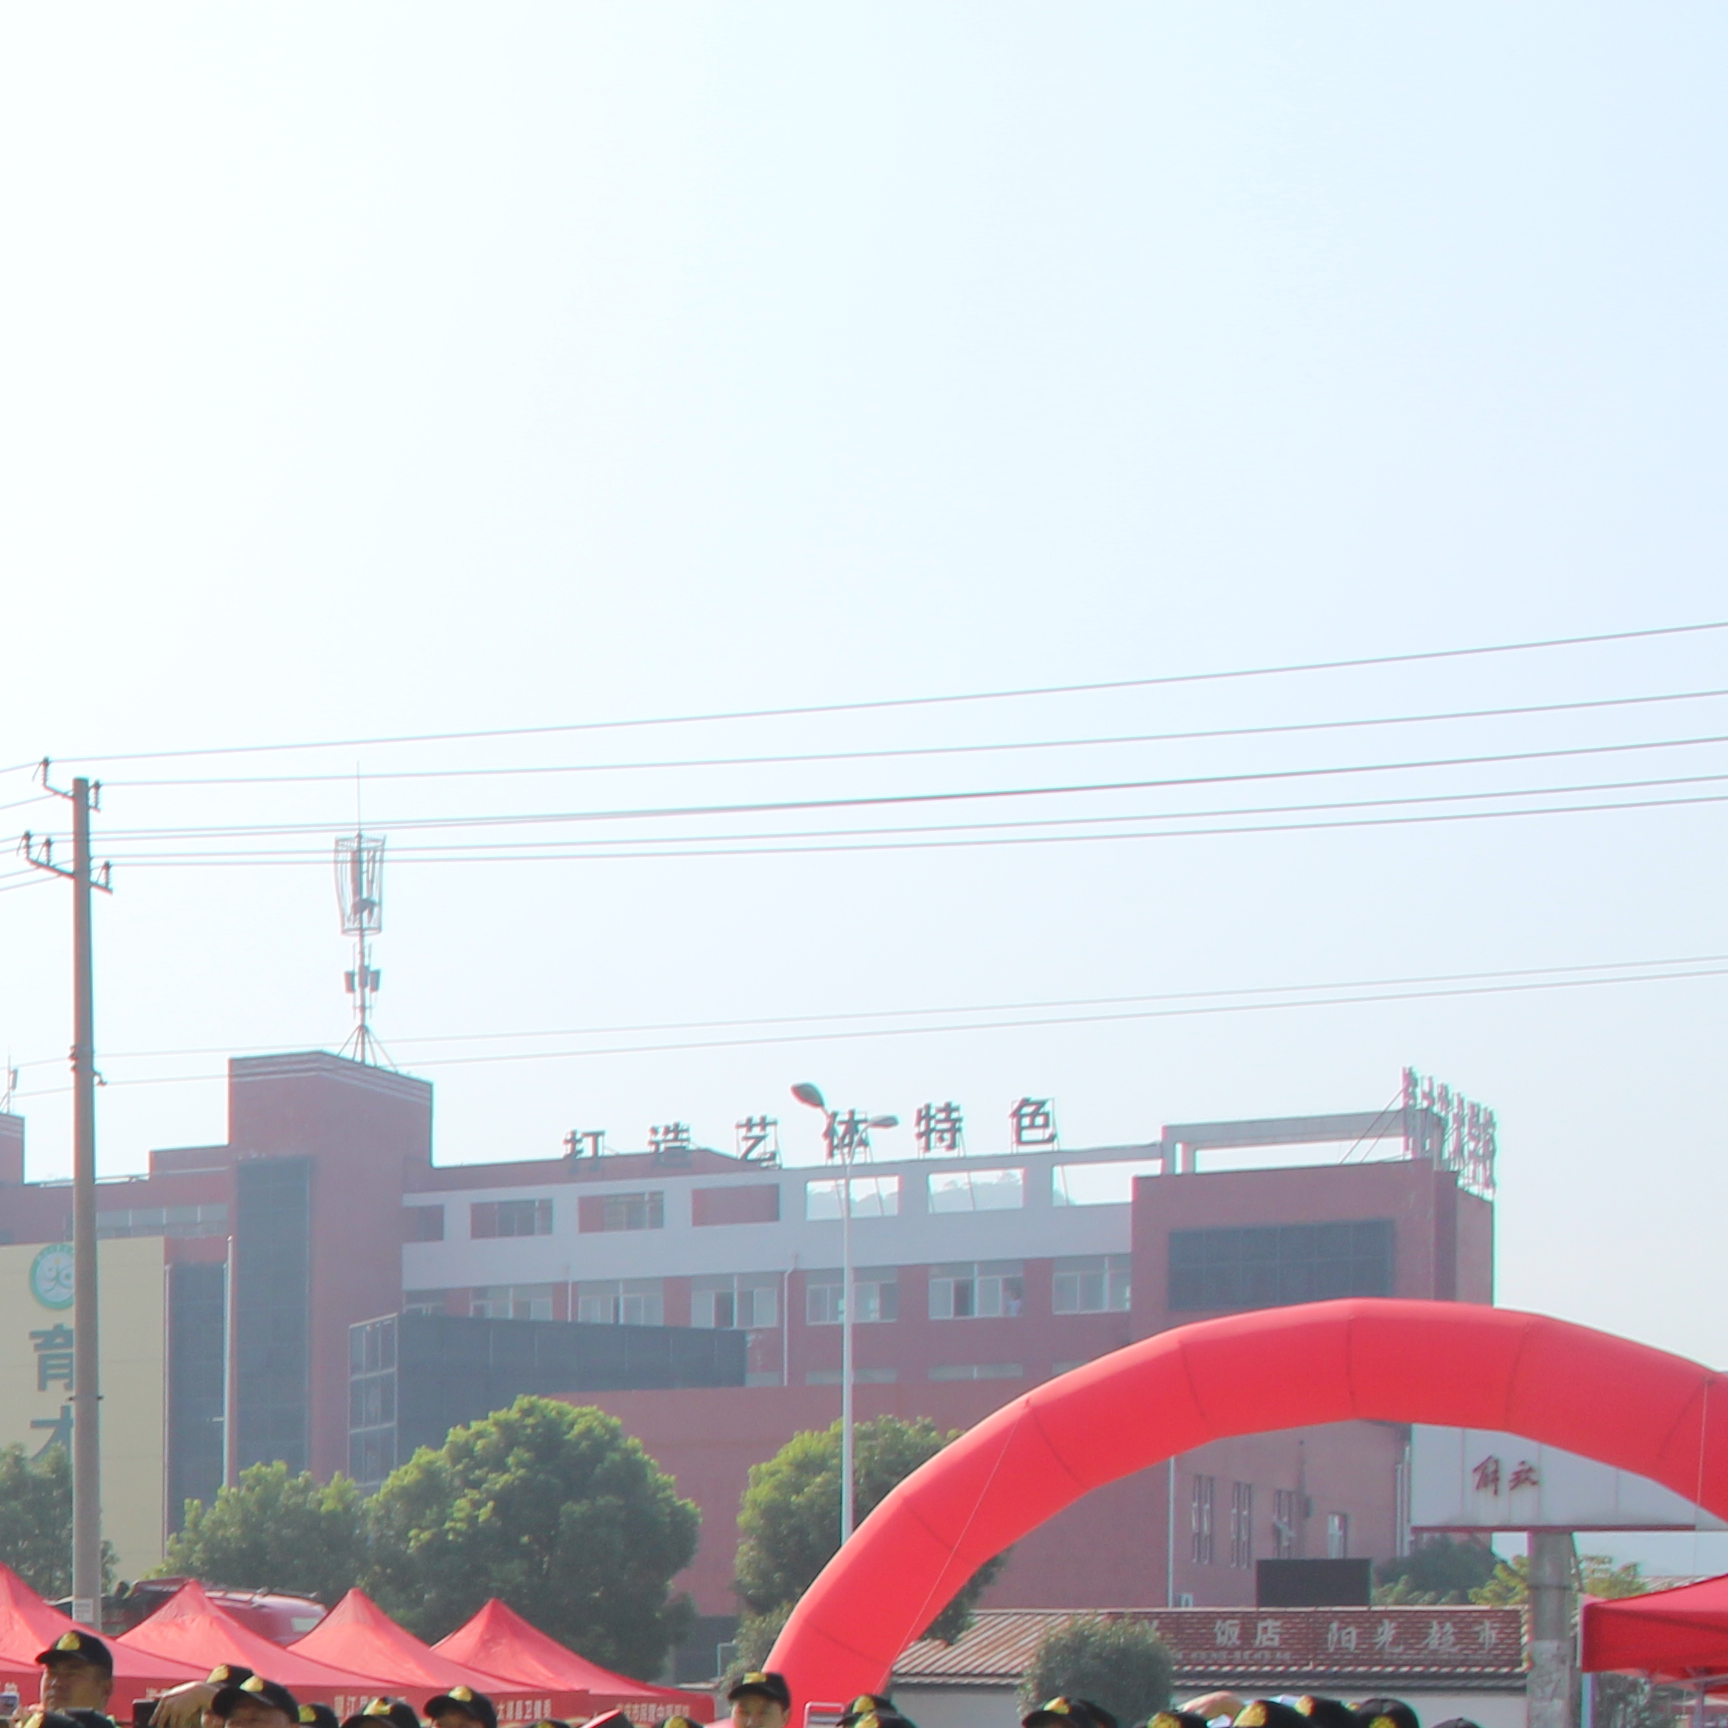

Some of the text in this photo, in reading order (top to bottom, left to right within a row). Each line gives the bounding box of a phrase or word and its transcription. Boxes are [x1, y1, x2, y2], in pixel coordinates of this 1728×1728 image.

[564, 1097, 1056, 1163] 打造艺体特色
[1213, 1618, 1283, 1649] 饭店
[1326, 1619, 1501, 1654] 阳光超市
